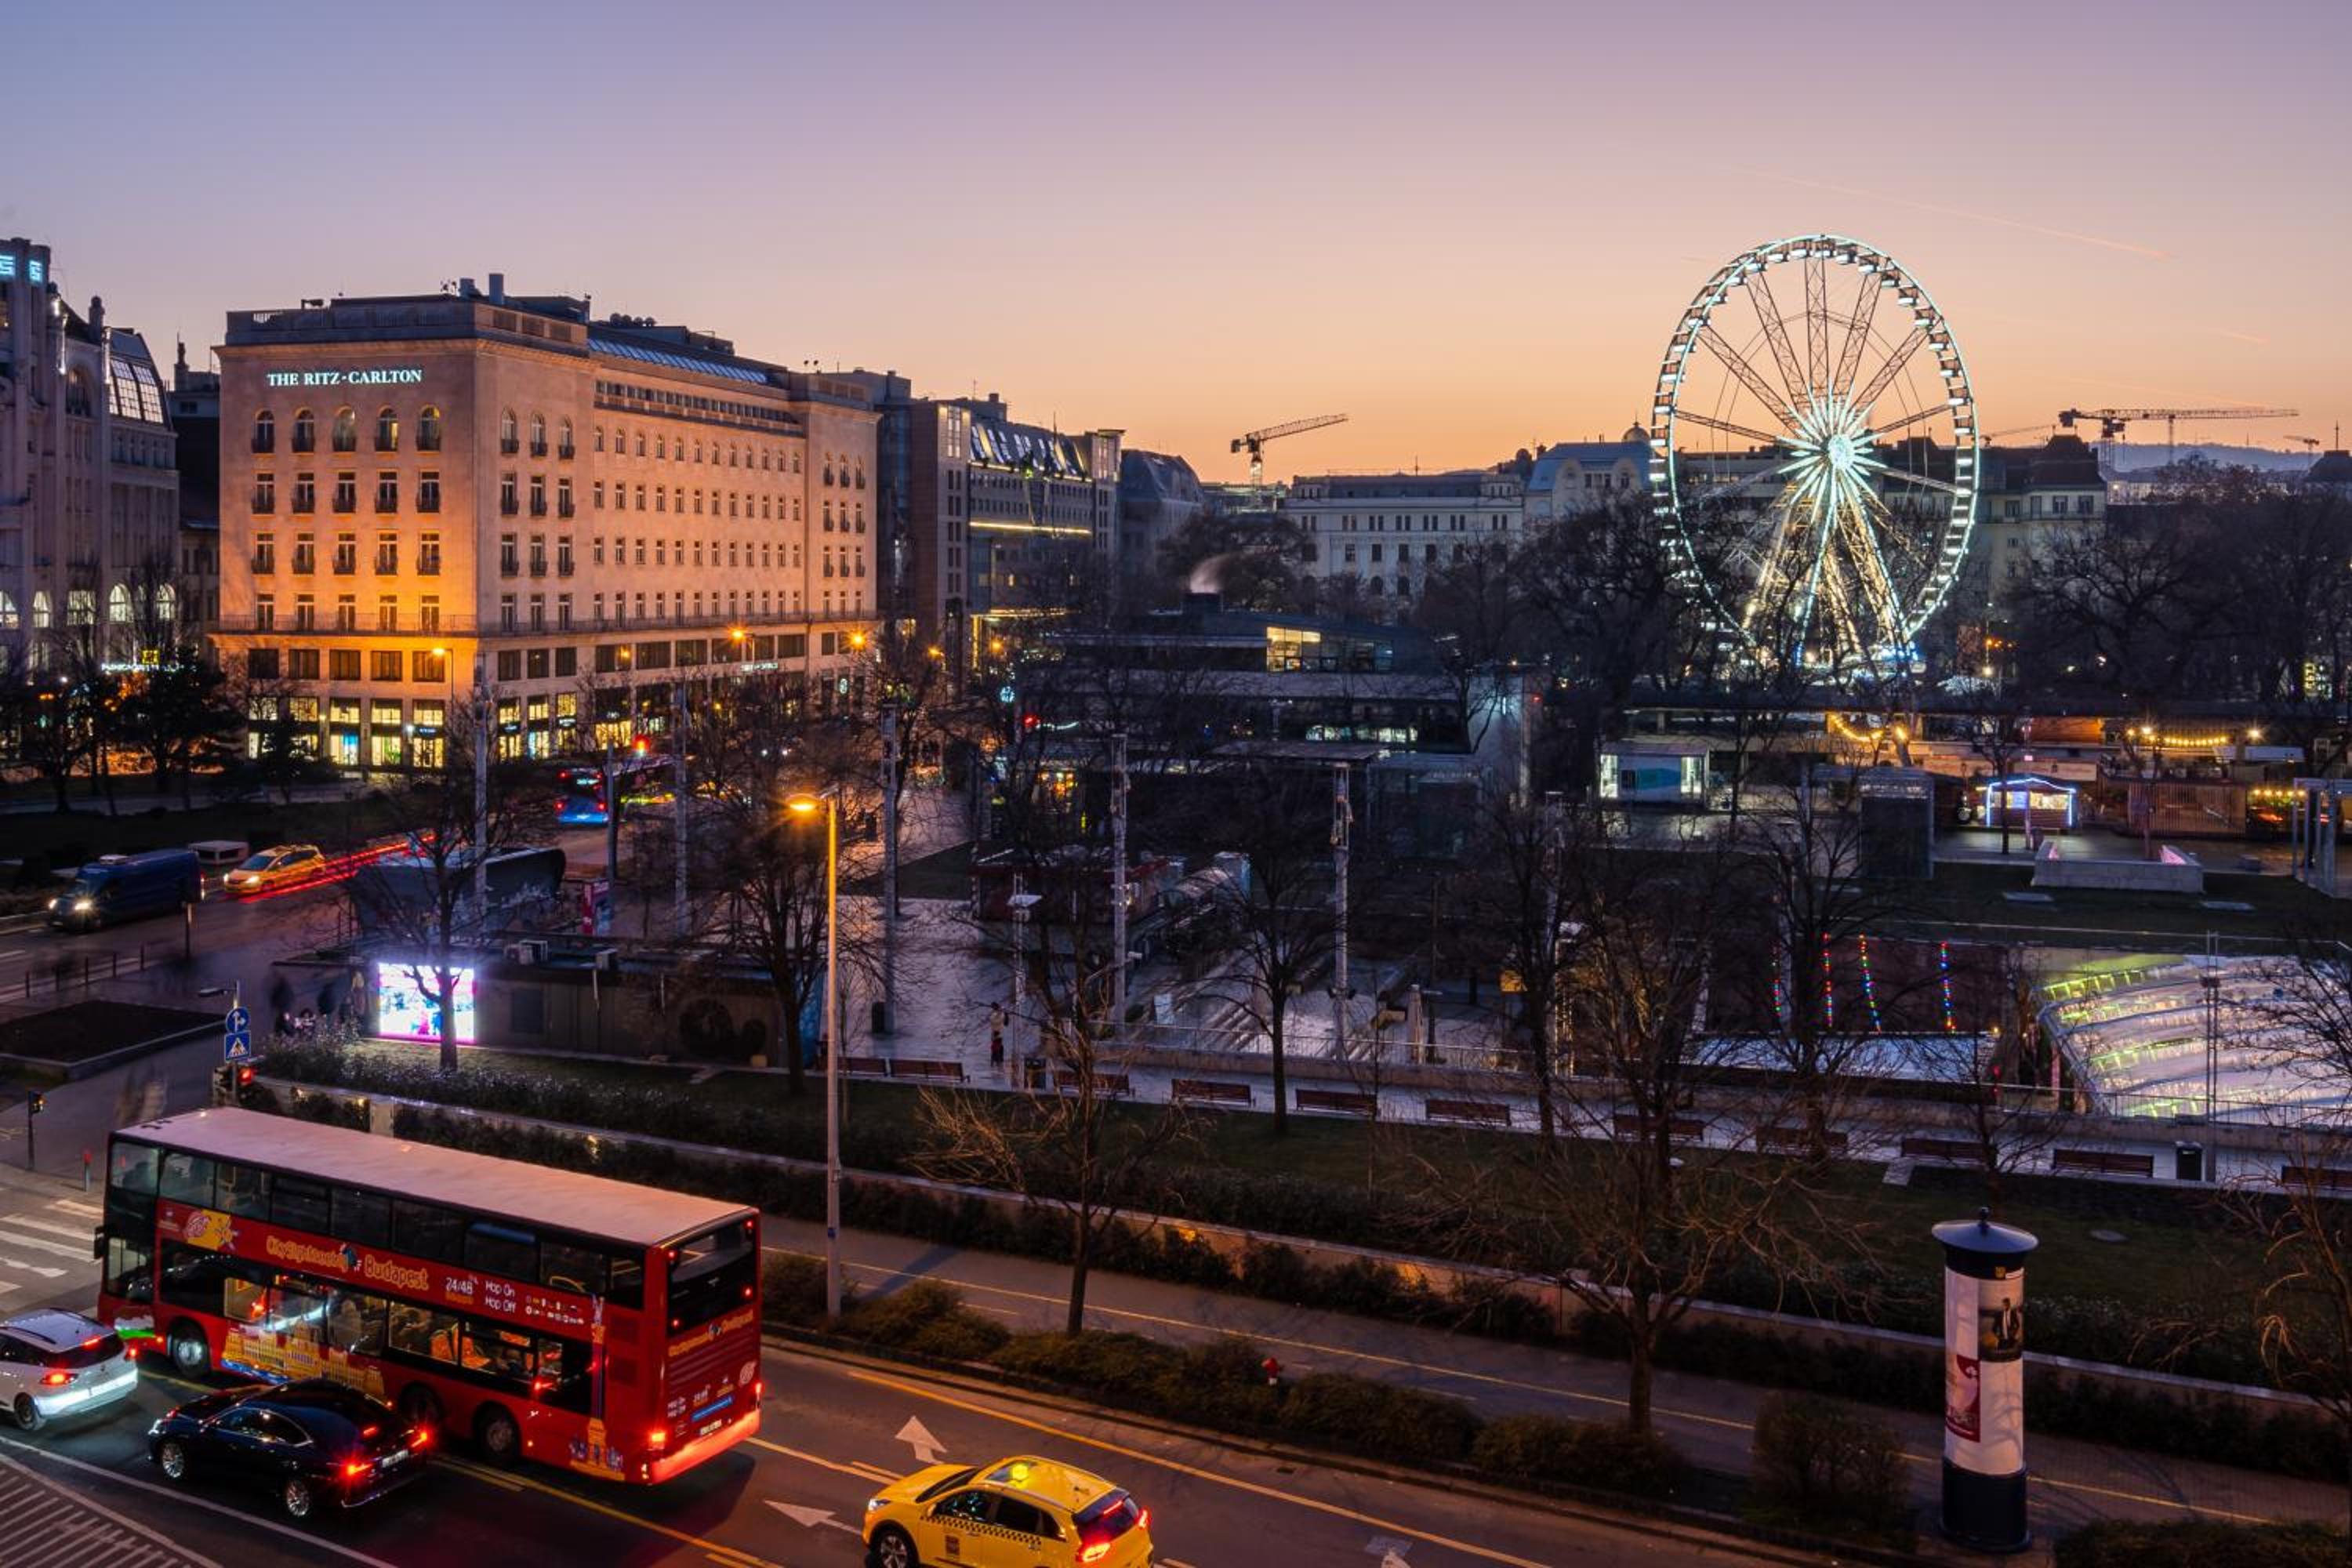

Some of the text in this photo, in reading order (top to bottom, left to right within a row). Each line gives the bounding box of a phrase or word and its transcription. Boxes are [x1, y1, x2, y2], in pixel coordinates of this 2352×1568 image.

[267, 372, 299, 387] THE
[365, 1254, 429, 1290] Budapest
[445, 1277, 474, 1295] 24/48
[485, 1280, 516, 1298] Hop On
[485, 1296, 502, 1309] Hop
[503, 1299, 517, 1314] Off
